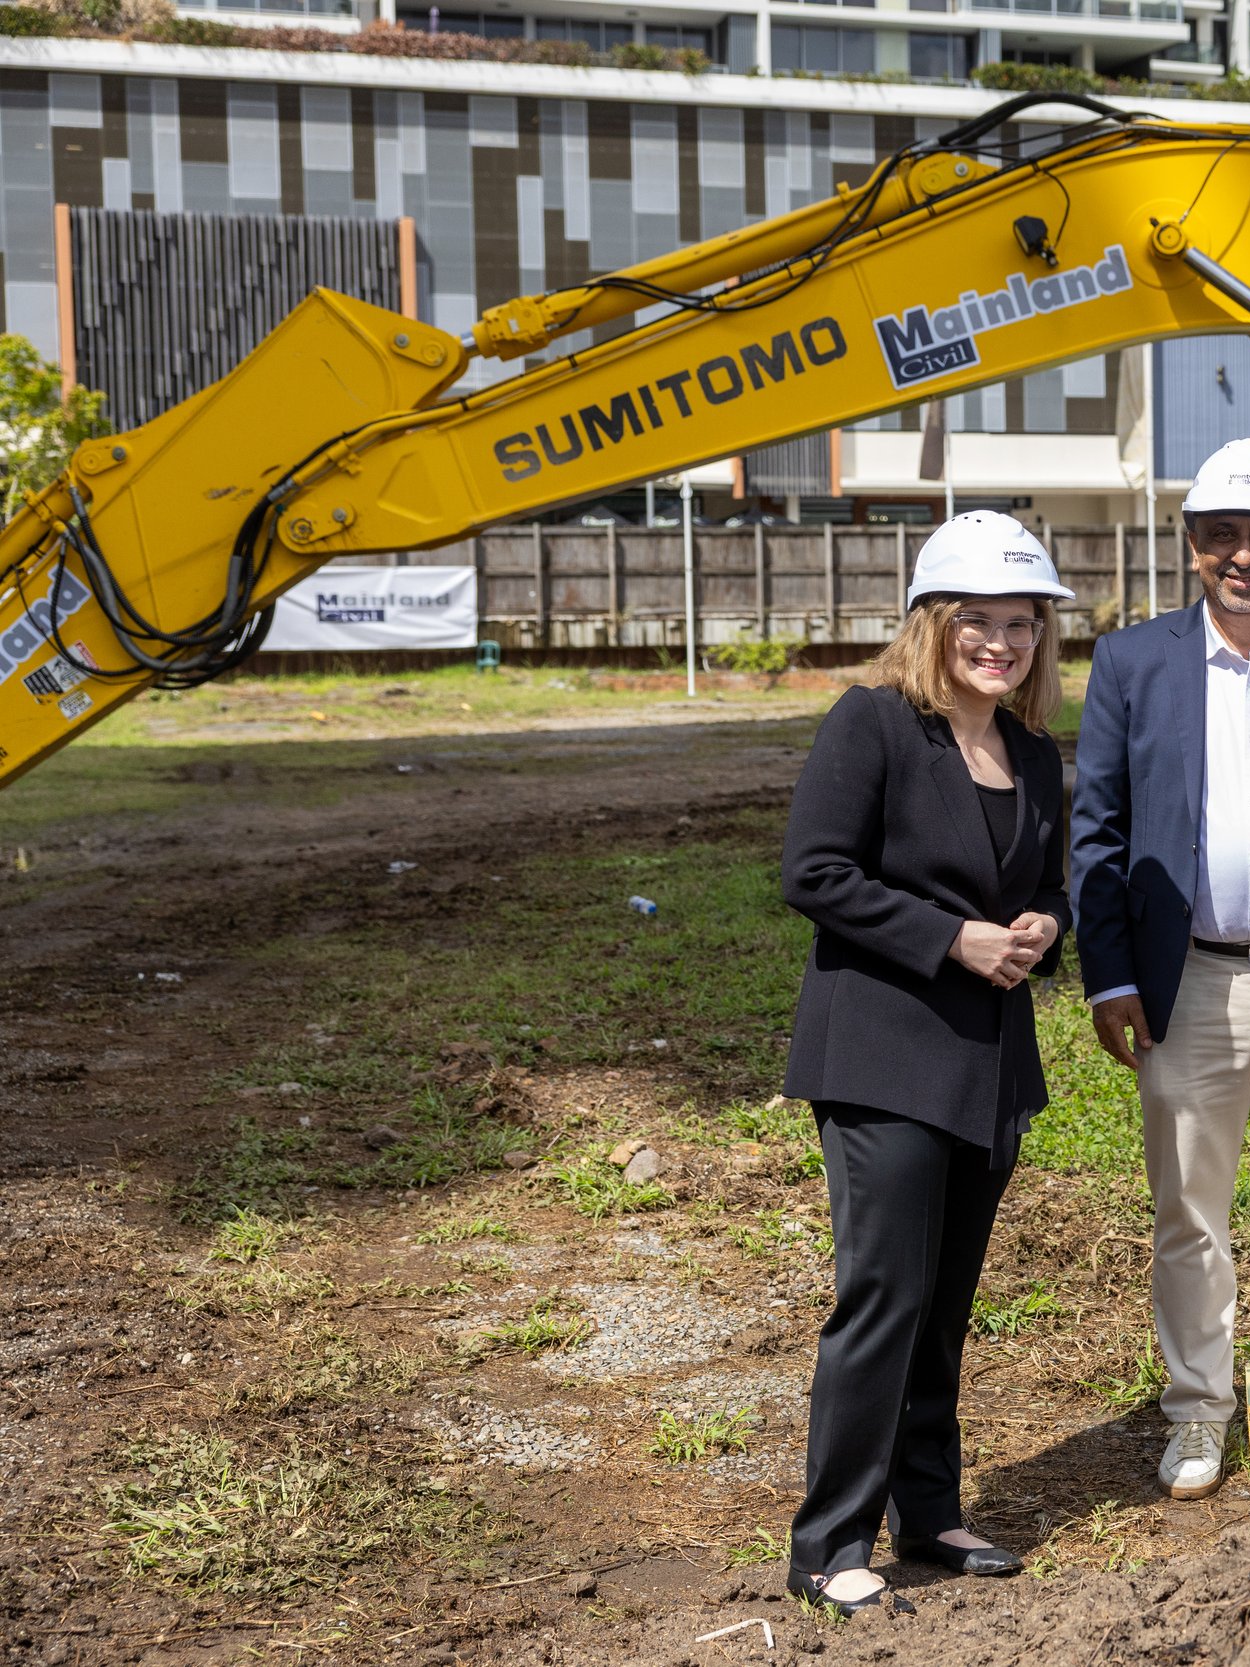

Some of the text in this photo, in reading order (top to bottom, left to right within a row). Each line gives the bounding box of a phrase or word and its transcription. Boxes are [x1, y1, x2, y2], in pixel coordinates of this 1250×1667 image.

[877, 248, 1131, 352] Mainland
[899, 343, 968, 379] Civil
[493, 316, 848, 483] SUMITOMO
[1003, 551, 1042, 561] Wentworth
[318, 592, 449, 607] Mainland
